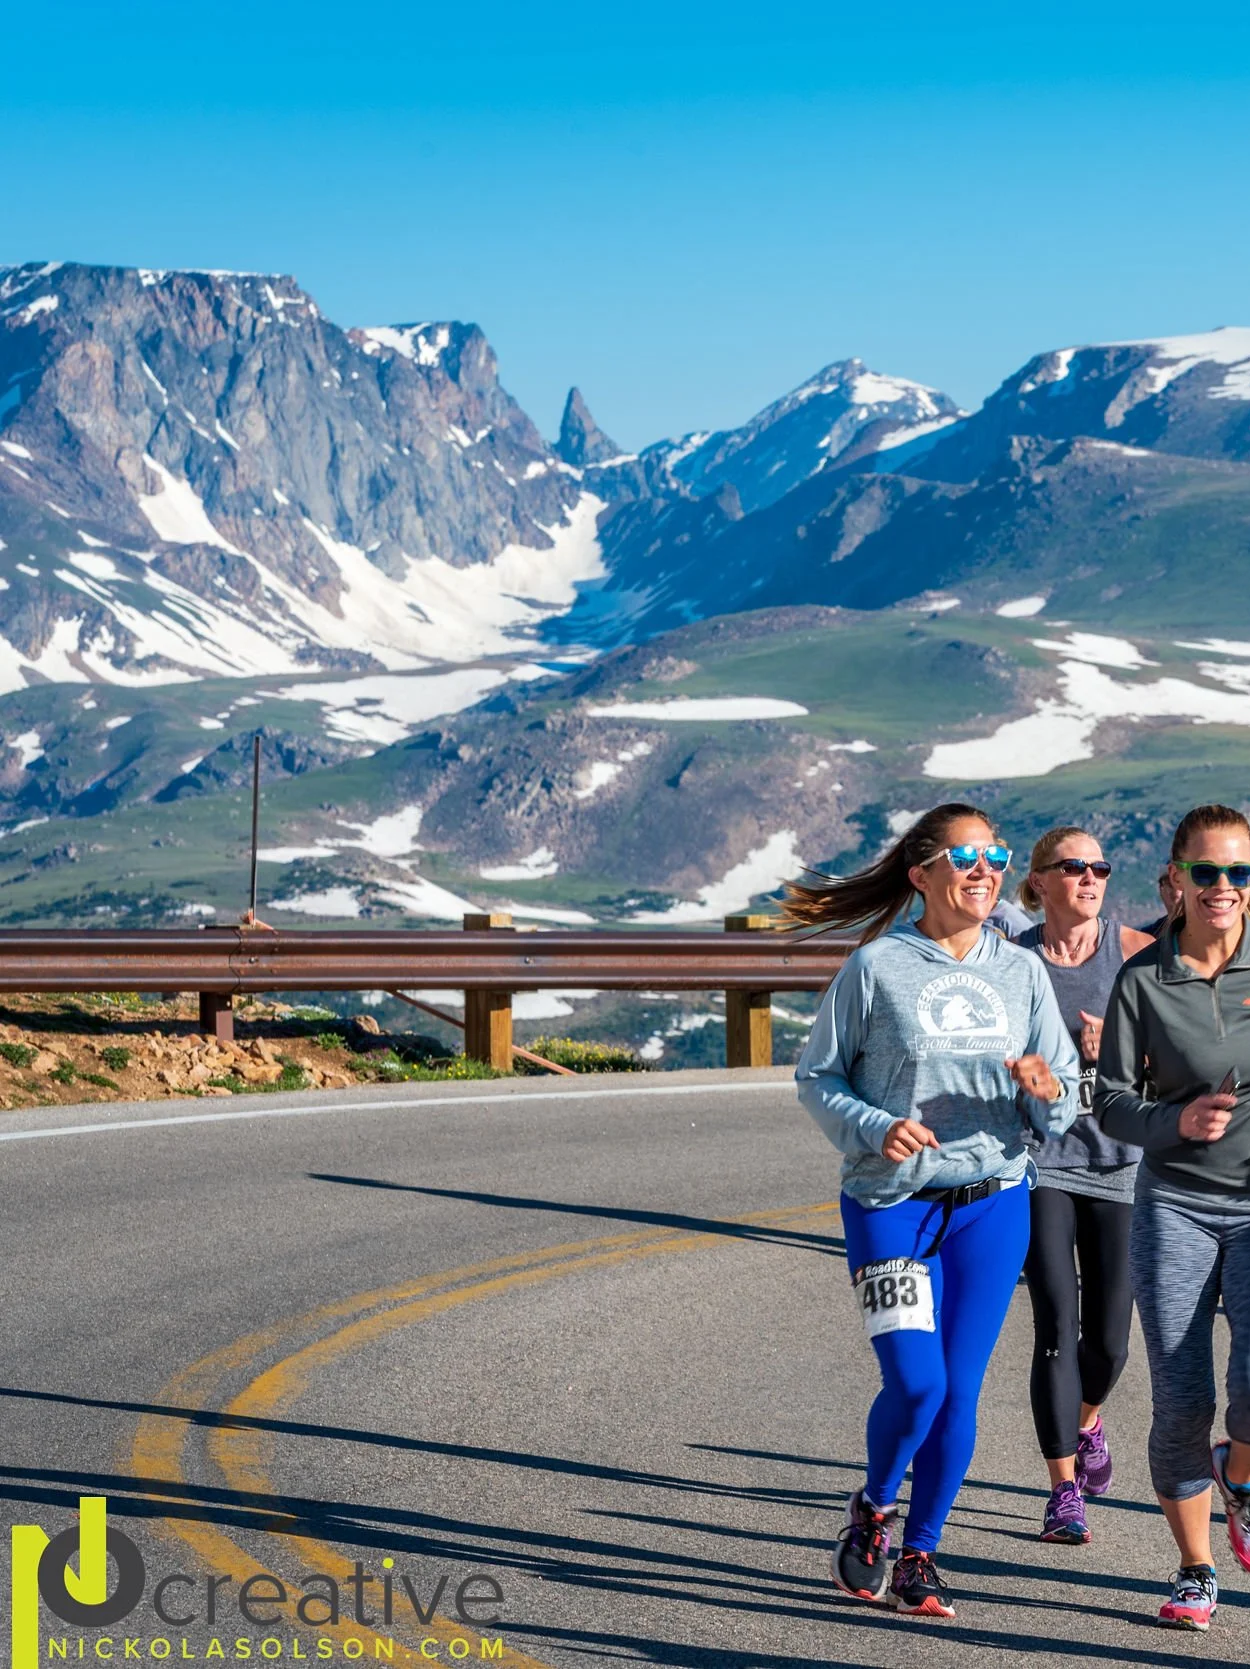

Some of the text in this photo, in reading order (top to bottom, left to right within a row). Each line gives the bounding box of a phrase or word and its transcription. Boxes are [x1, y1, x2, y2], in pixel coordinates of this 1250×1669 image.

[918, 974, 988, 1012] BEARTOOTH
[920, 1036, 952, 1050] 50th
[863, 1276, 918, 1313] 483
